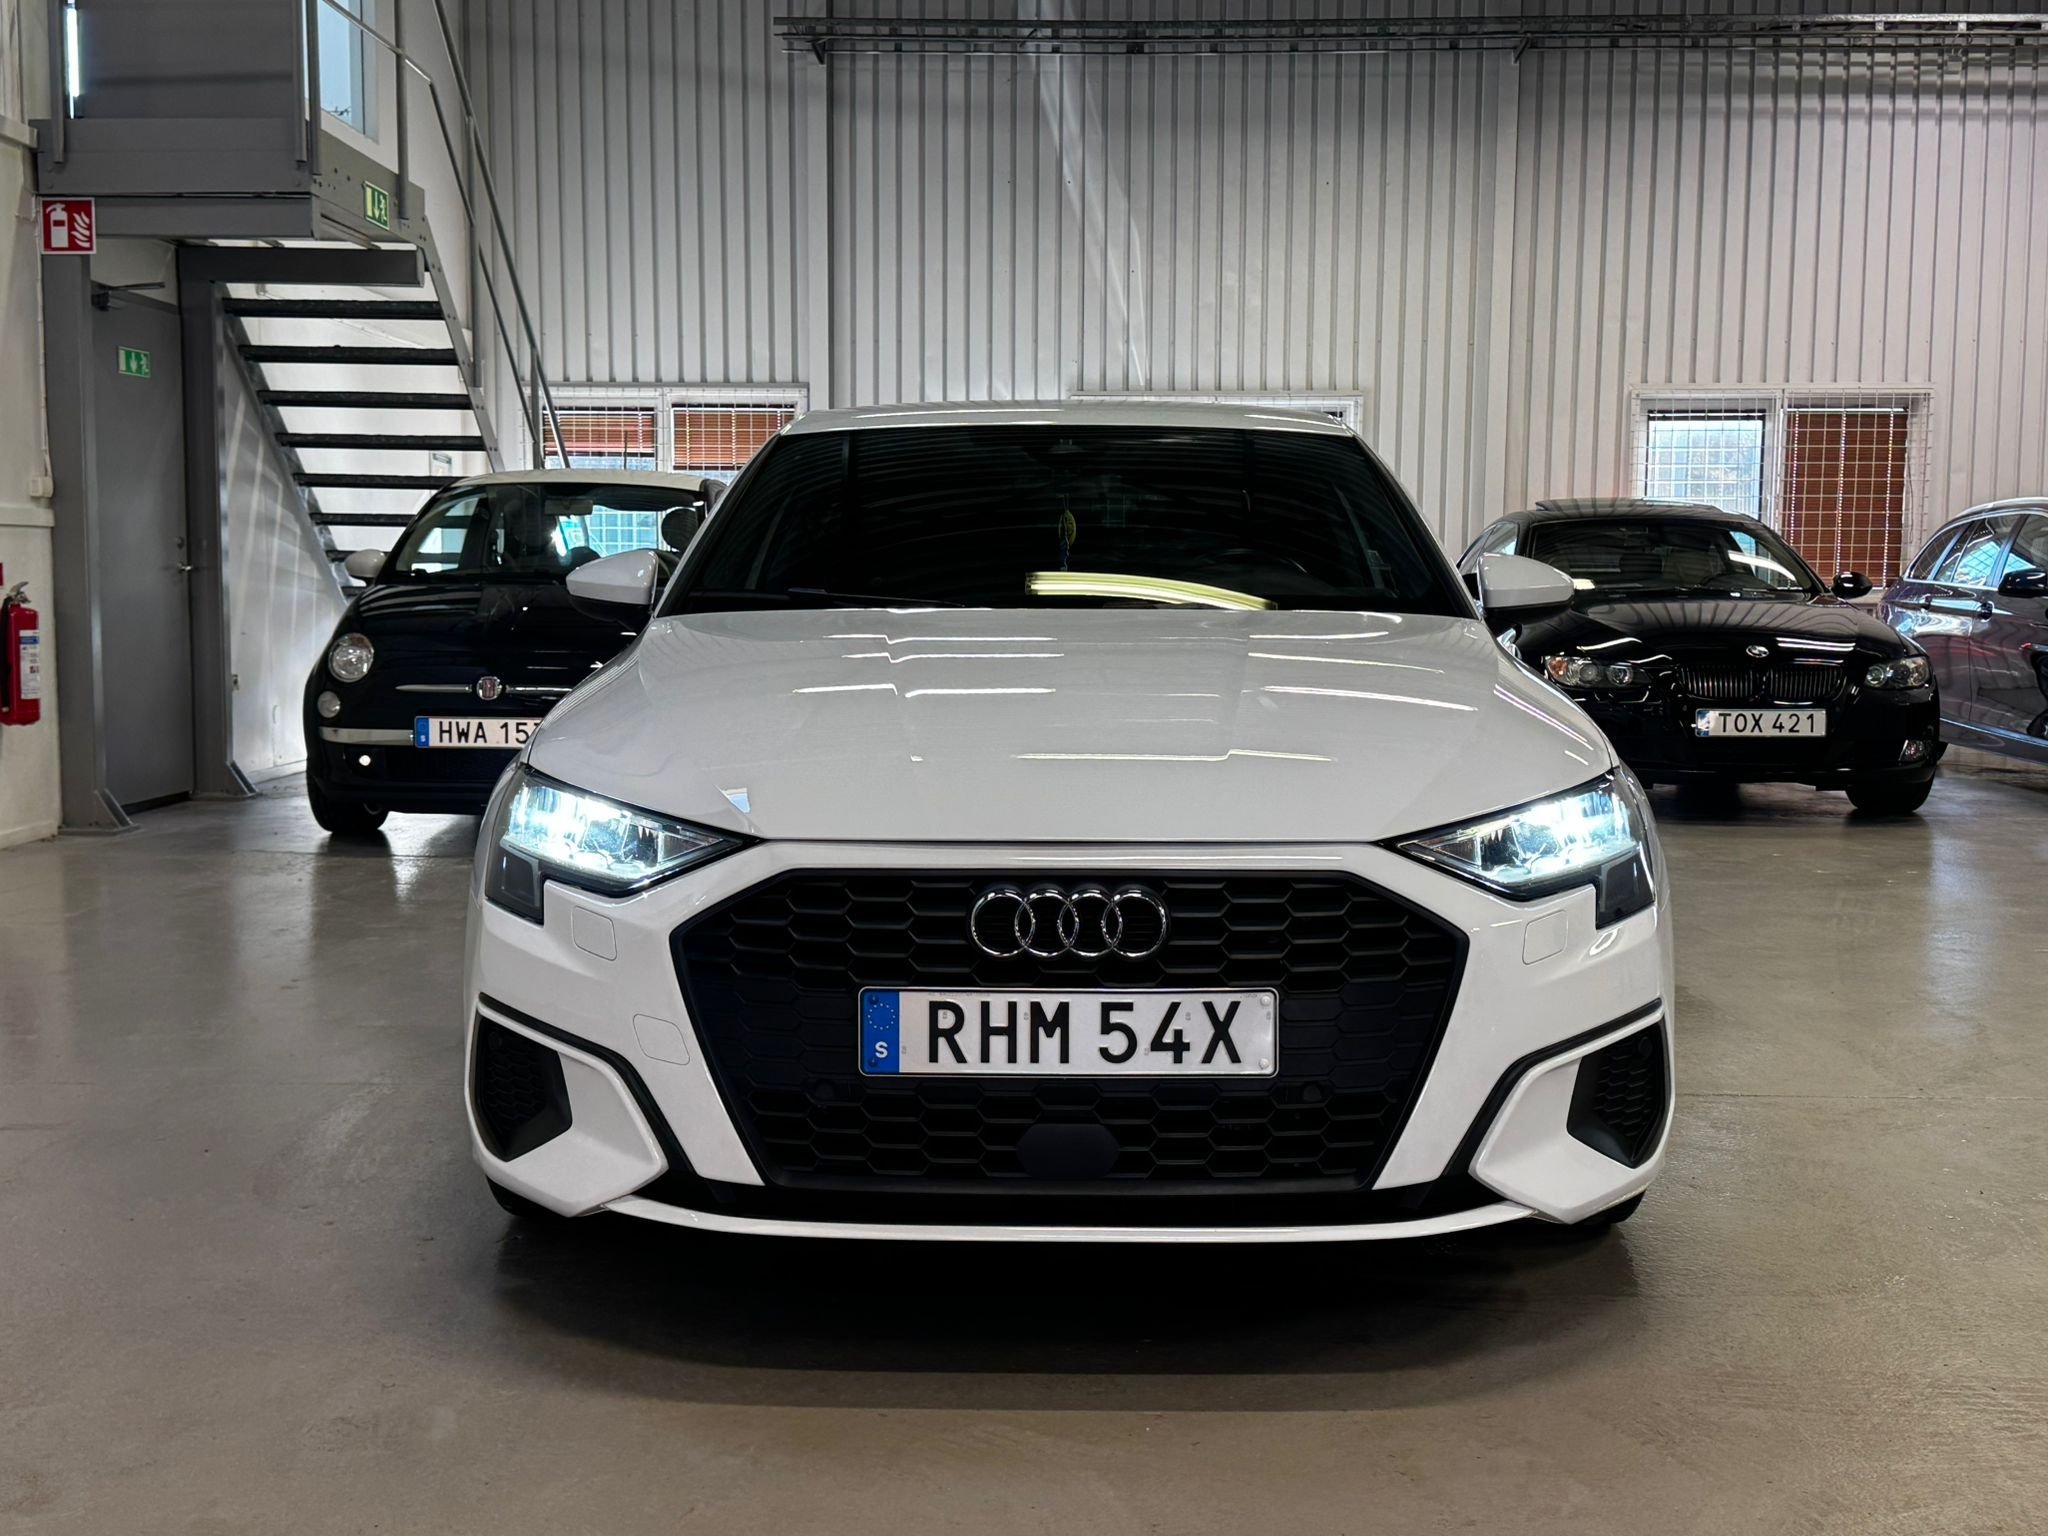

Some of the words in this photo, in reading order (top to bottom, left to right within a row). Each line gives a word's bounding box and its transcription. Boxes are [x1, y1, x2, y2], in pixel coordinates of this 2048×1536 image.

[439, 721, 487, 743] HWA
[500, 722, 540, 744] 15
[1718, 713, 1763, 733] TOX
[1772, 713, 1815, 733] 421
[929, 1000, 1070, 1064] RHM
[1098, 1001, 1242, 1064] 54X
[875, 1041, 888, 1058] S
